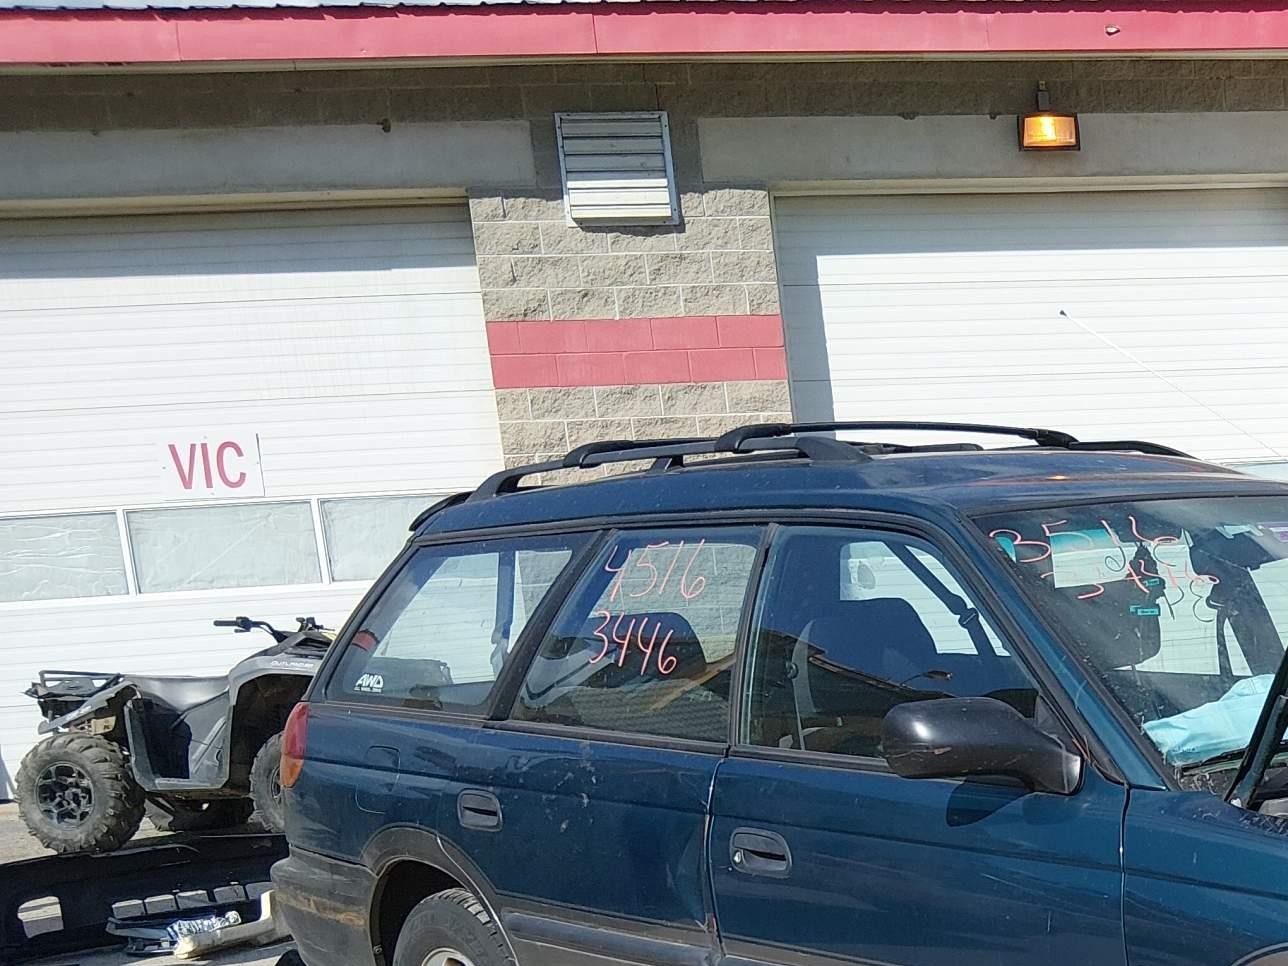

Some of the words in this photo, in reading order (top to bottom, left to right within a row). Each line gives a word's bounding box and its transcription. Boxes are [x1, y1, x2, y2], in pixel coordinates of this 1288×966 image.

[168, 441, 247, 490] VIC
[605, 538, 706, 602] 4516
[588, 610, 678, 676] 3446
[355, 673, 384, 688] AWD
